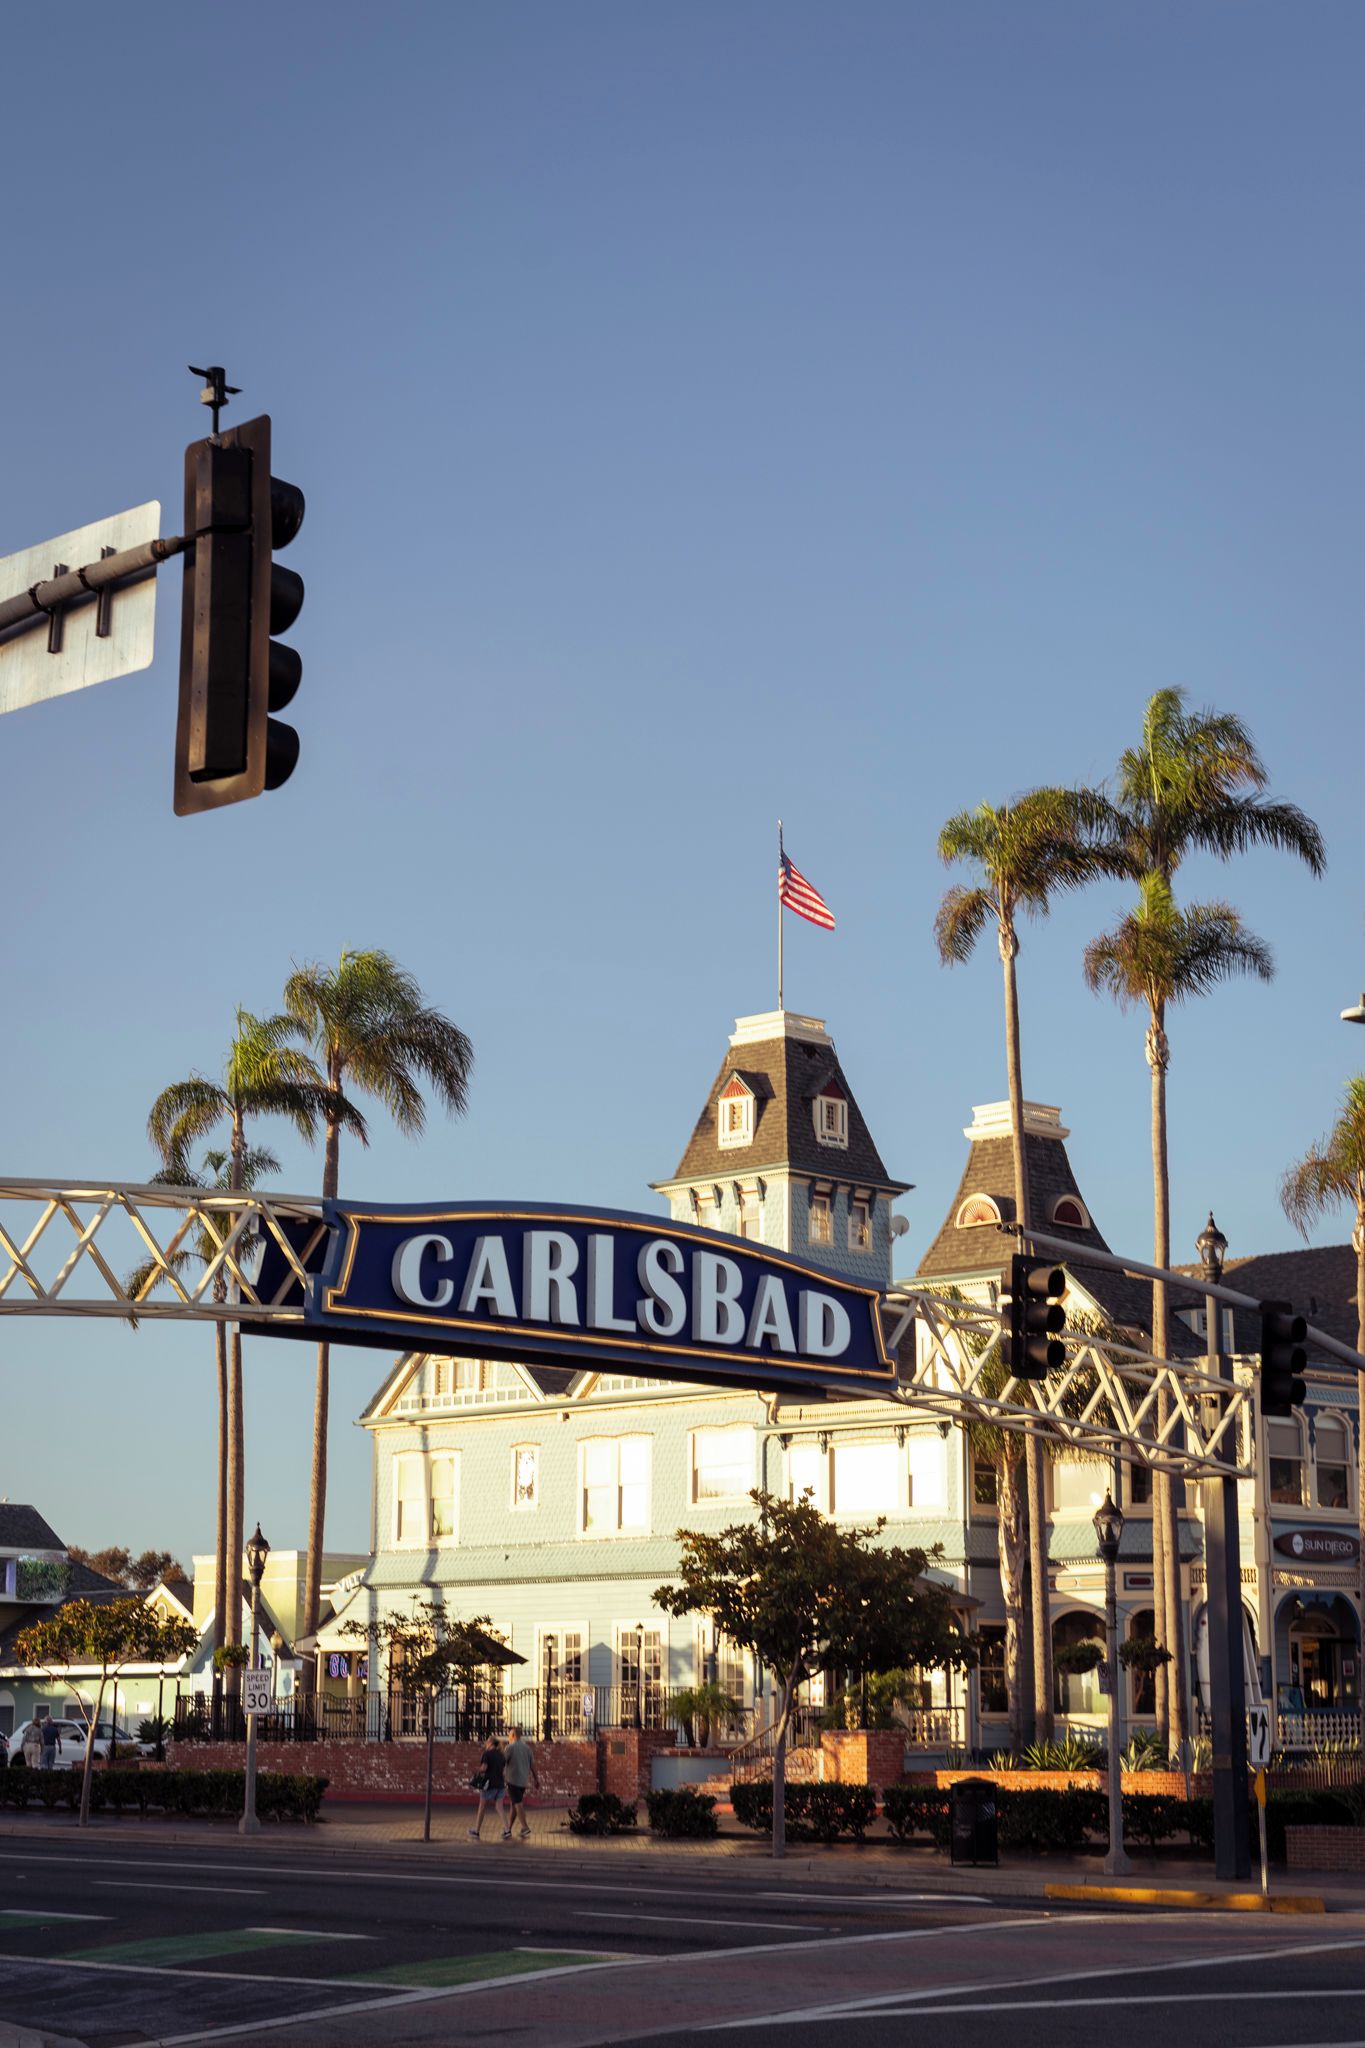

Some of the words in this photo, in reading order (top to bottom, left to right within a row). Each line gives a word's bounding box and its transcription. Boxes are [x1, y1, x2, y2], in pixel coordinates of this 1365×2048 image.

[391, 1230, 852, 1357] CARLSBAD
[1304, 1539, 1323, 1551] SUN
[1325, 1541, 1353, 1555] DIEGO
[246, 1674, 270, 1682] SPEED
[247, 1693, 268, 1709] 30
